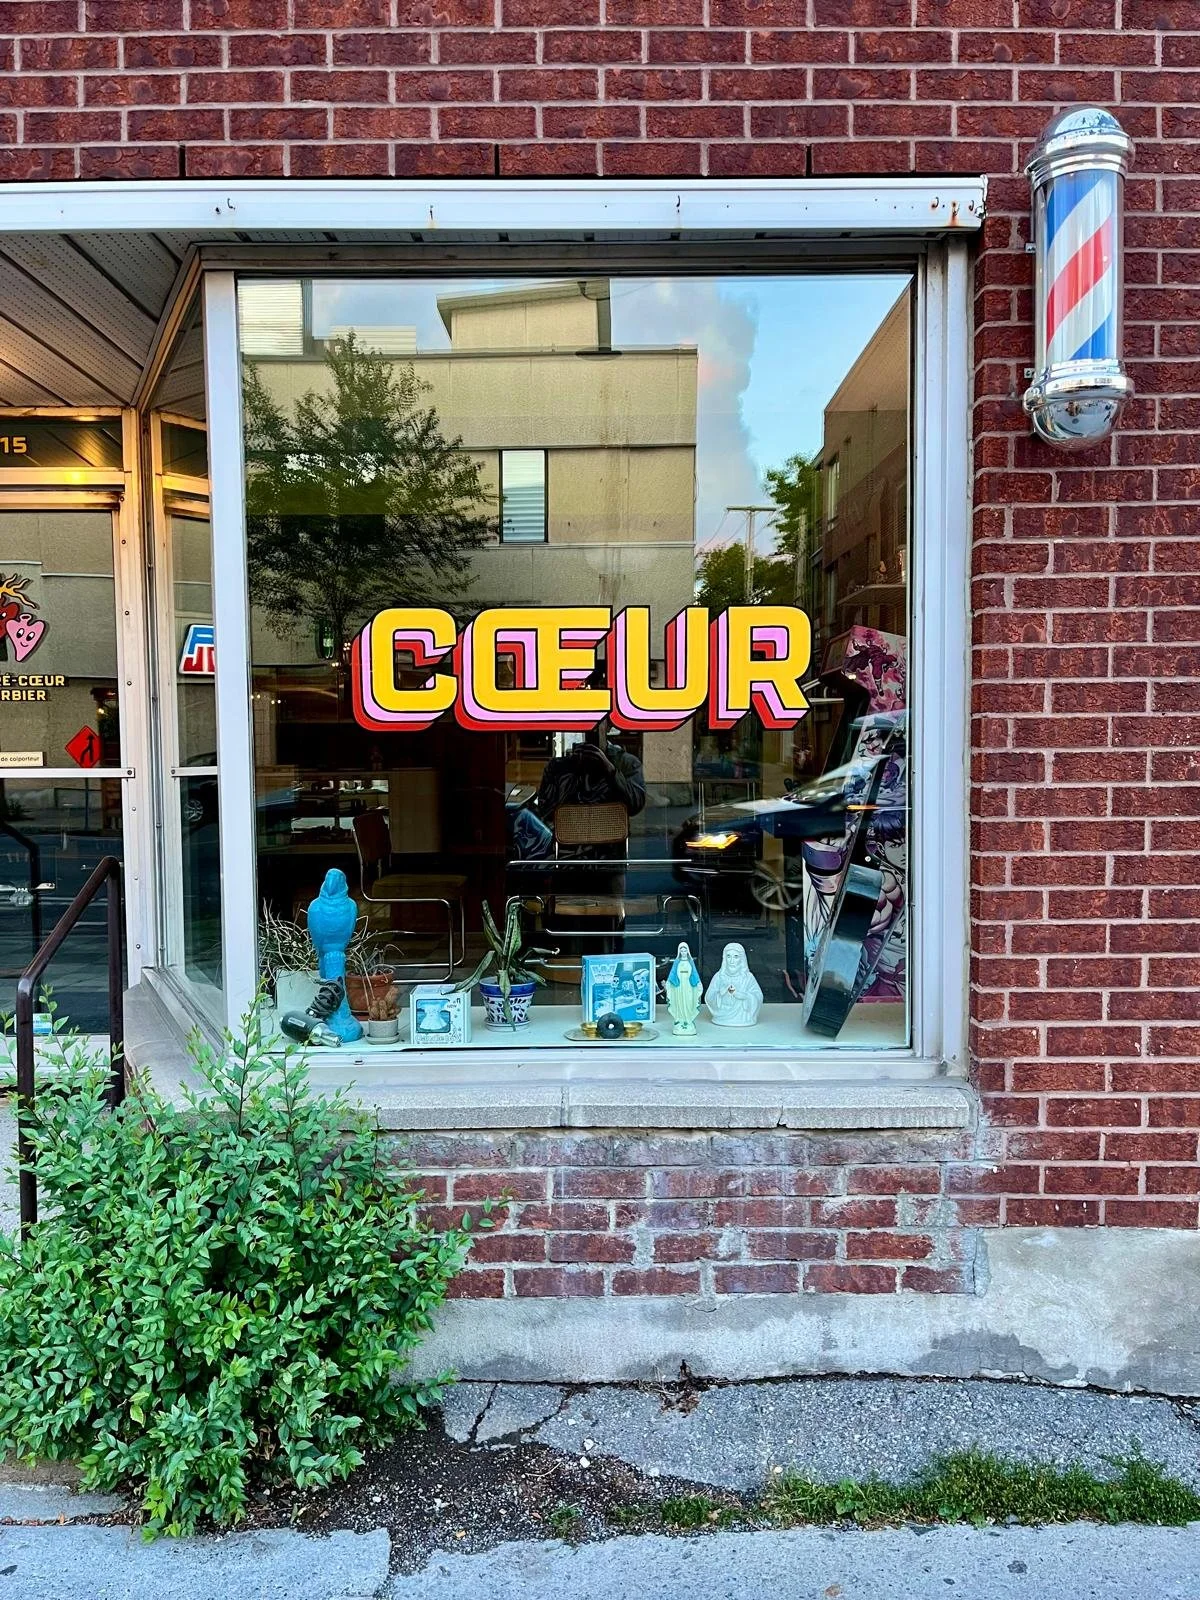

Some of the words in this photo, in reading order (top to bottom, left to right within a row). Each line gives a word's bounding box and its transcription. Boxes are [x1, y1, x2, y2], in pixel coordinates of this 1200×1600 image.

[0, 436, 27, 453] 15
[351, 605, 812, 732] CŒUR
[0, 673, 65, 686] É-CŒUR
